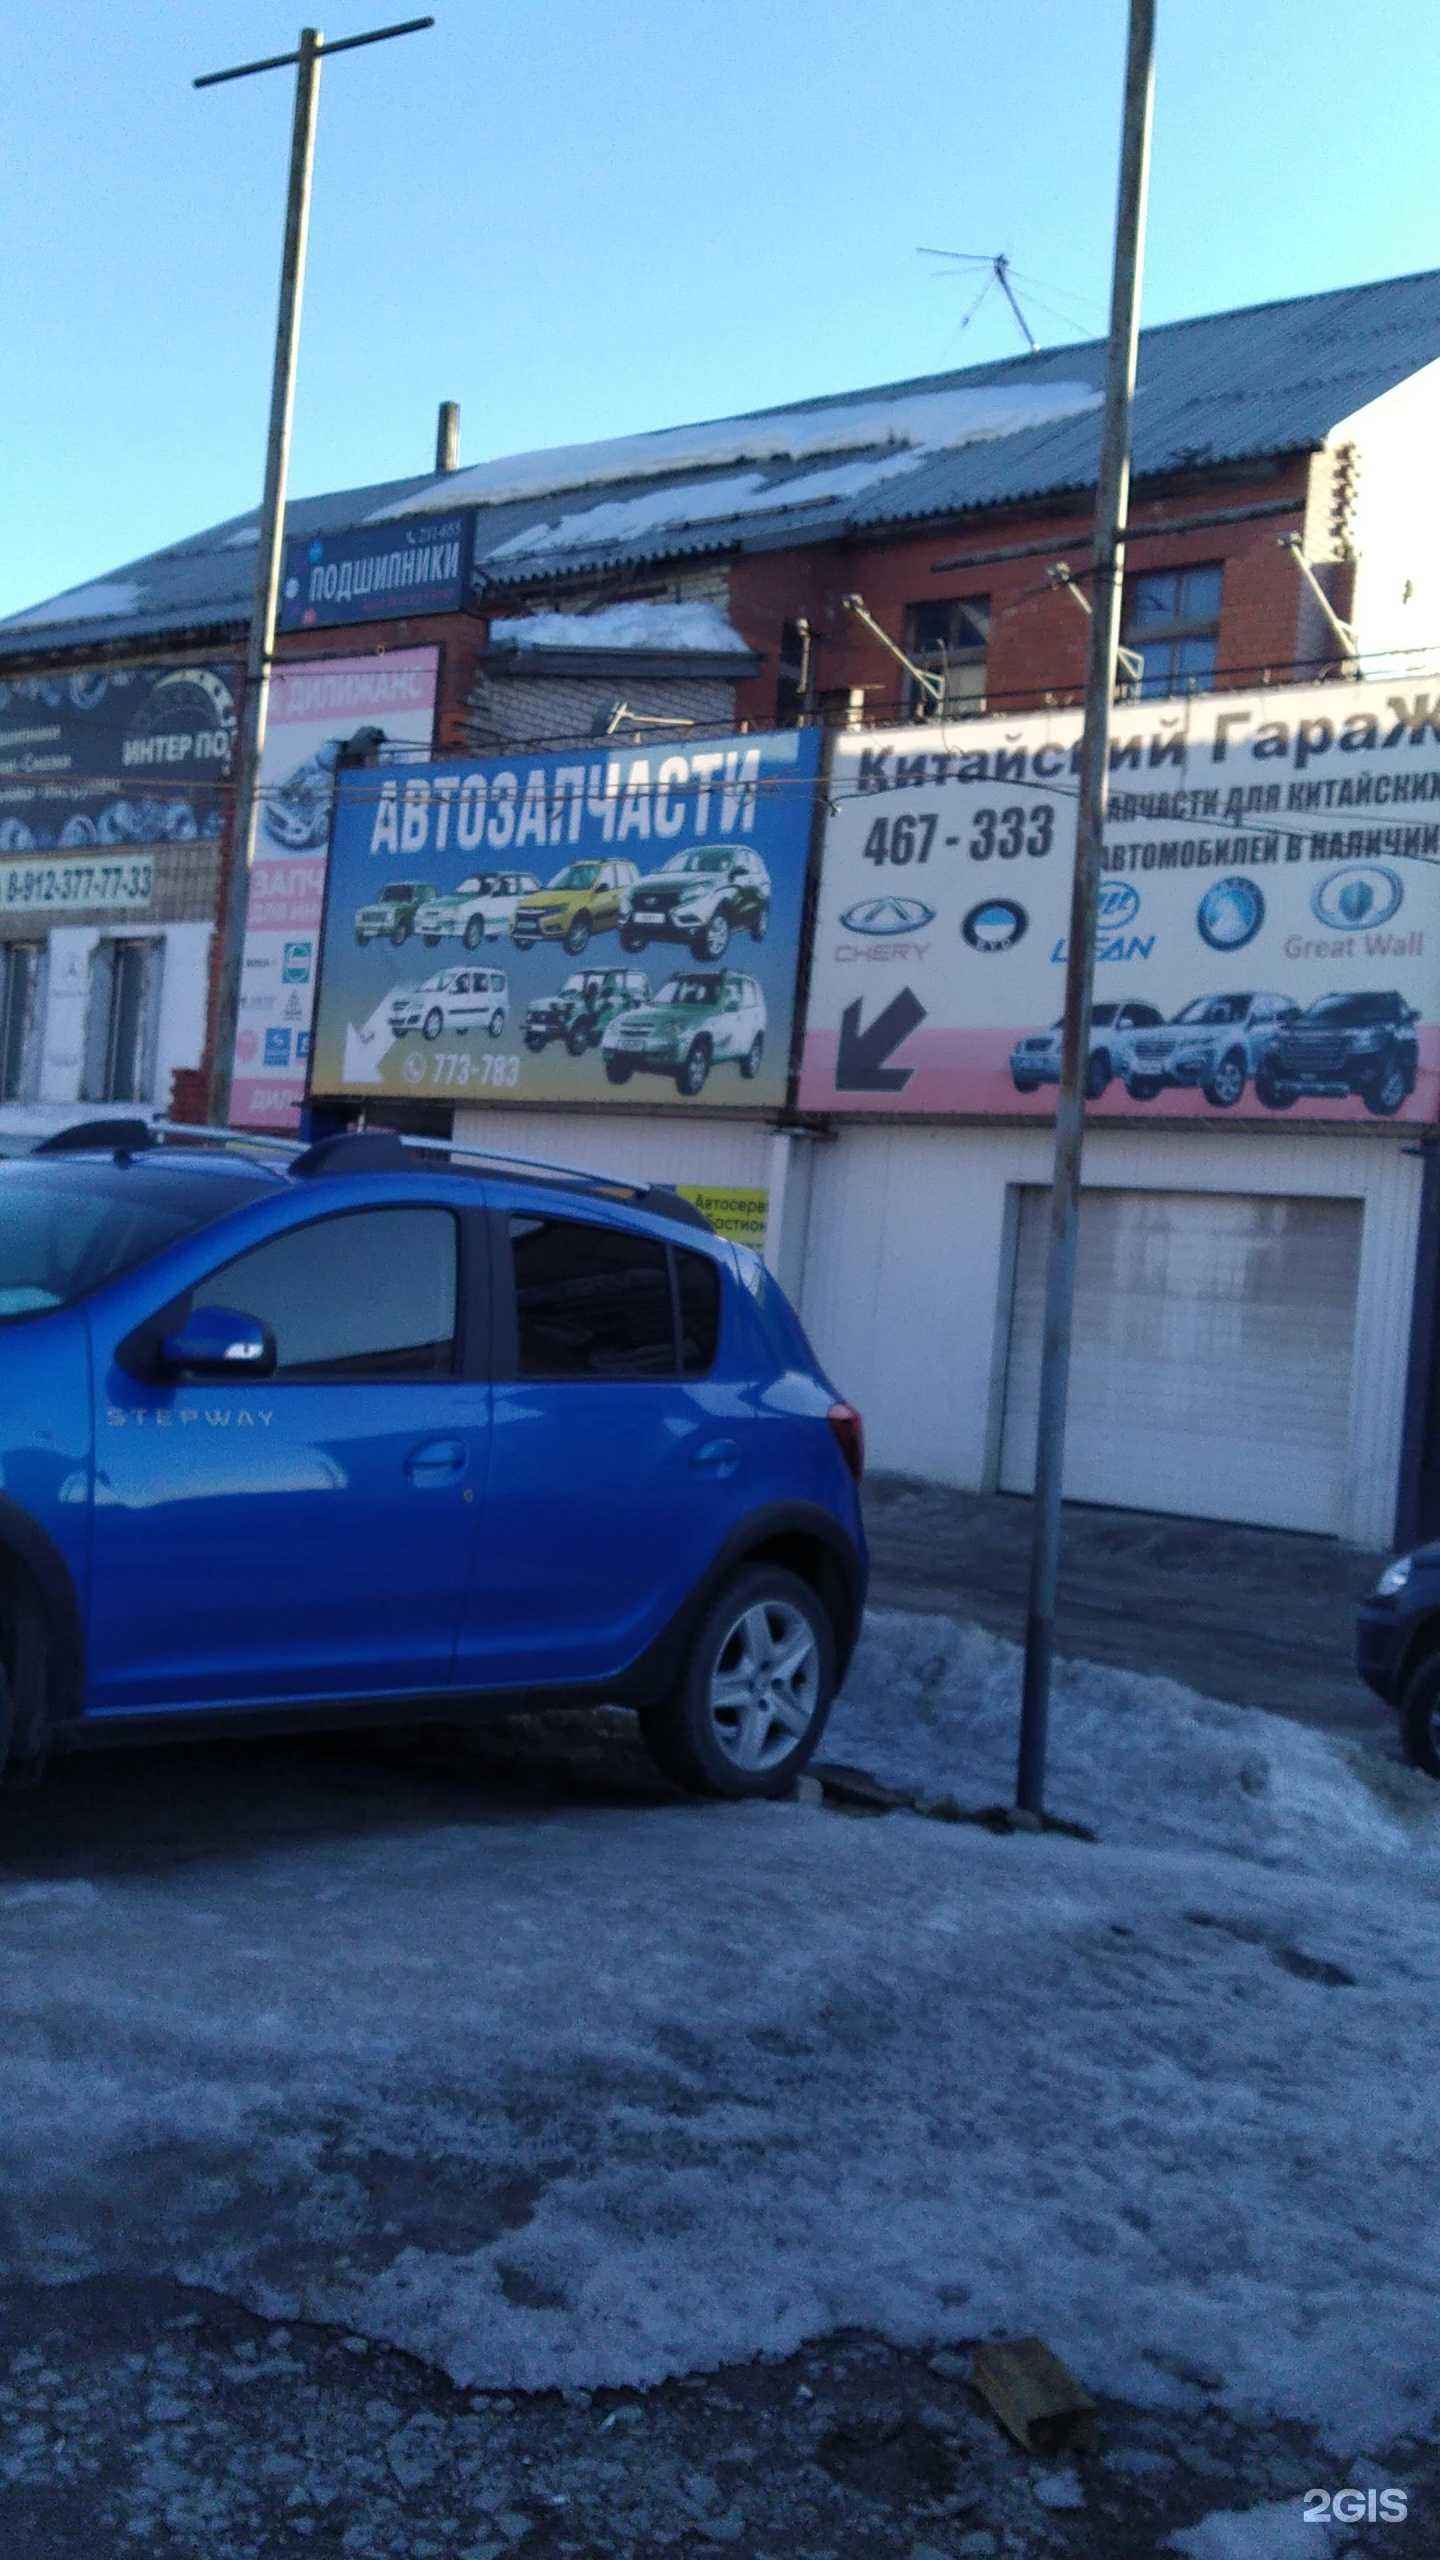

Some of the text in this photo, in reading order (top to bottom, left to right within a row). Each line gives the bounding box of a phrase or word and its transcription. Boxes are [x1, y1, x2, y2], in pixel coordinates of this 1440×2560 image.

[309, 543, 461, 601] ПОДШИПНИКИ
[122, 729, 233, 767] ИНТЕР ПО
[370, 749, 761, 856] АВТОЗАПЧАСТИ
[1106, 788, 1218, 824] АПЧАСТИ
[1224, 784, 1281, 818] ДЛЯ
[1285, 833, 1303, 861] В
[1309, 822, 1439, 861] НАЛИЧИИ
[251, 867, 324, 899] ЗАПЧ
[834, 941, 931, 962] CHERY
[1284, 930, 1424, 960] Great Wall
[106, 1407, 274, 1428] STEPWAY
